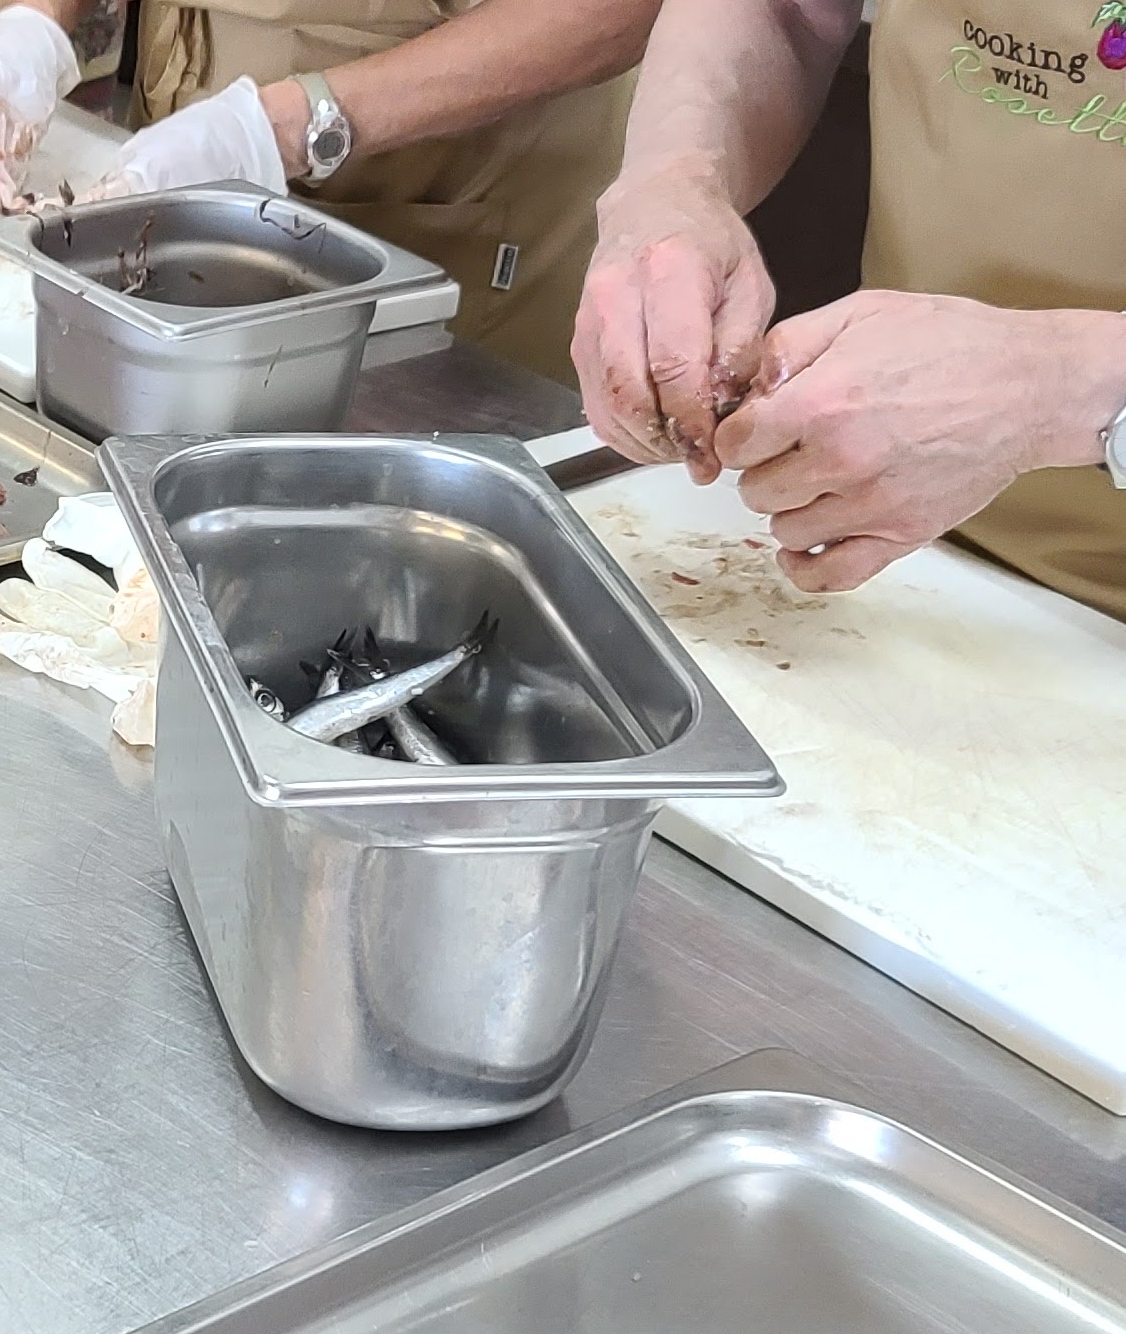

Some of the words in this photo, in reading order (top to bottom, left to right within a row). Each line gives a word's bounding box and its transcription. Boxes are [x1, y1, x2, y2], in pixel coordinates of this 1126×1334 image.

[963, 19, 1090, 84] cooking
[991, 66, 1049, 100] with
[938, 44, 1126, 147] Rosett
